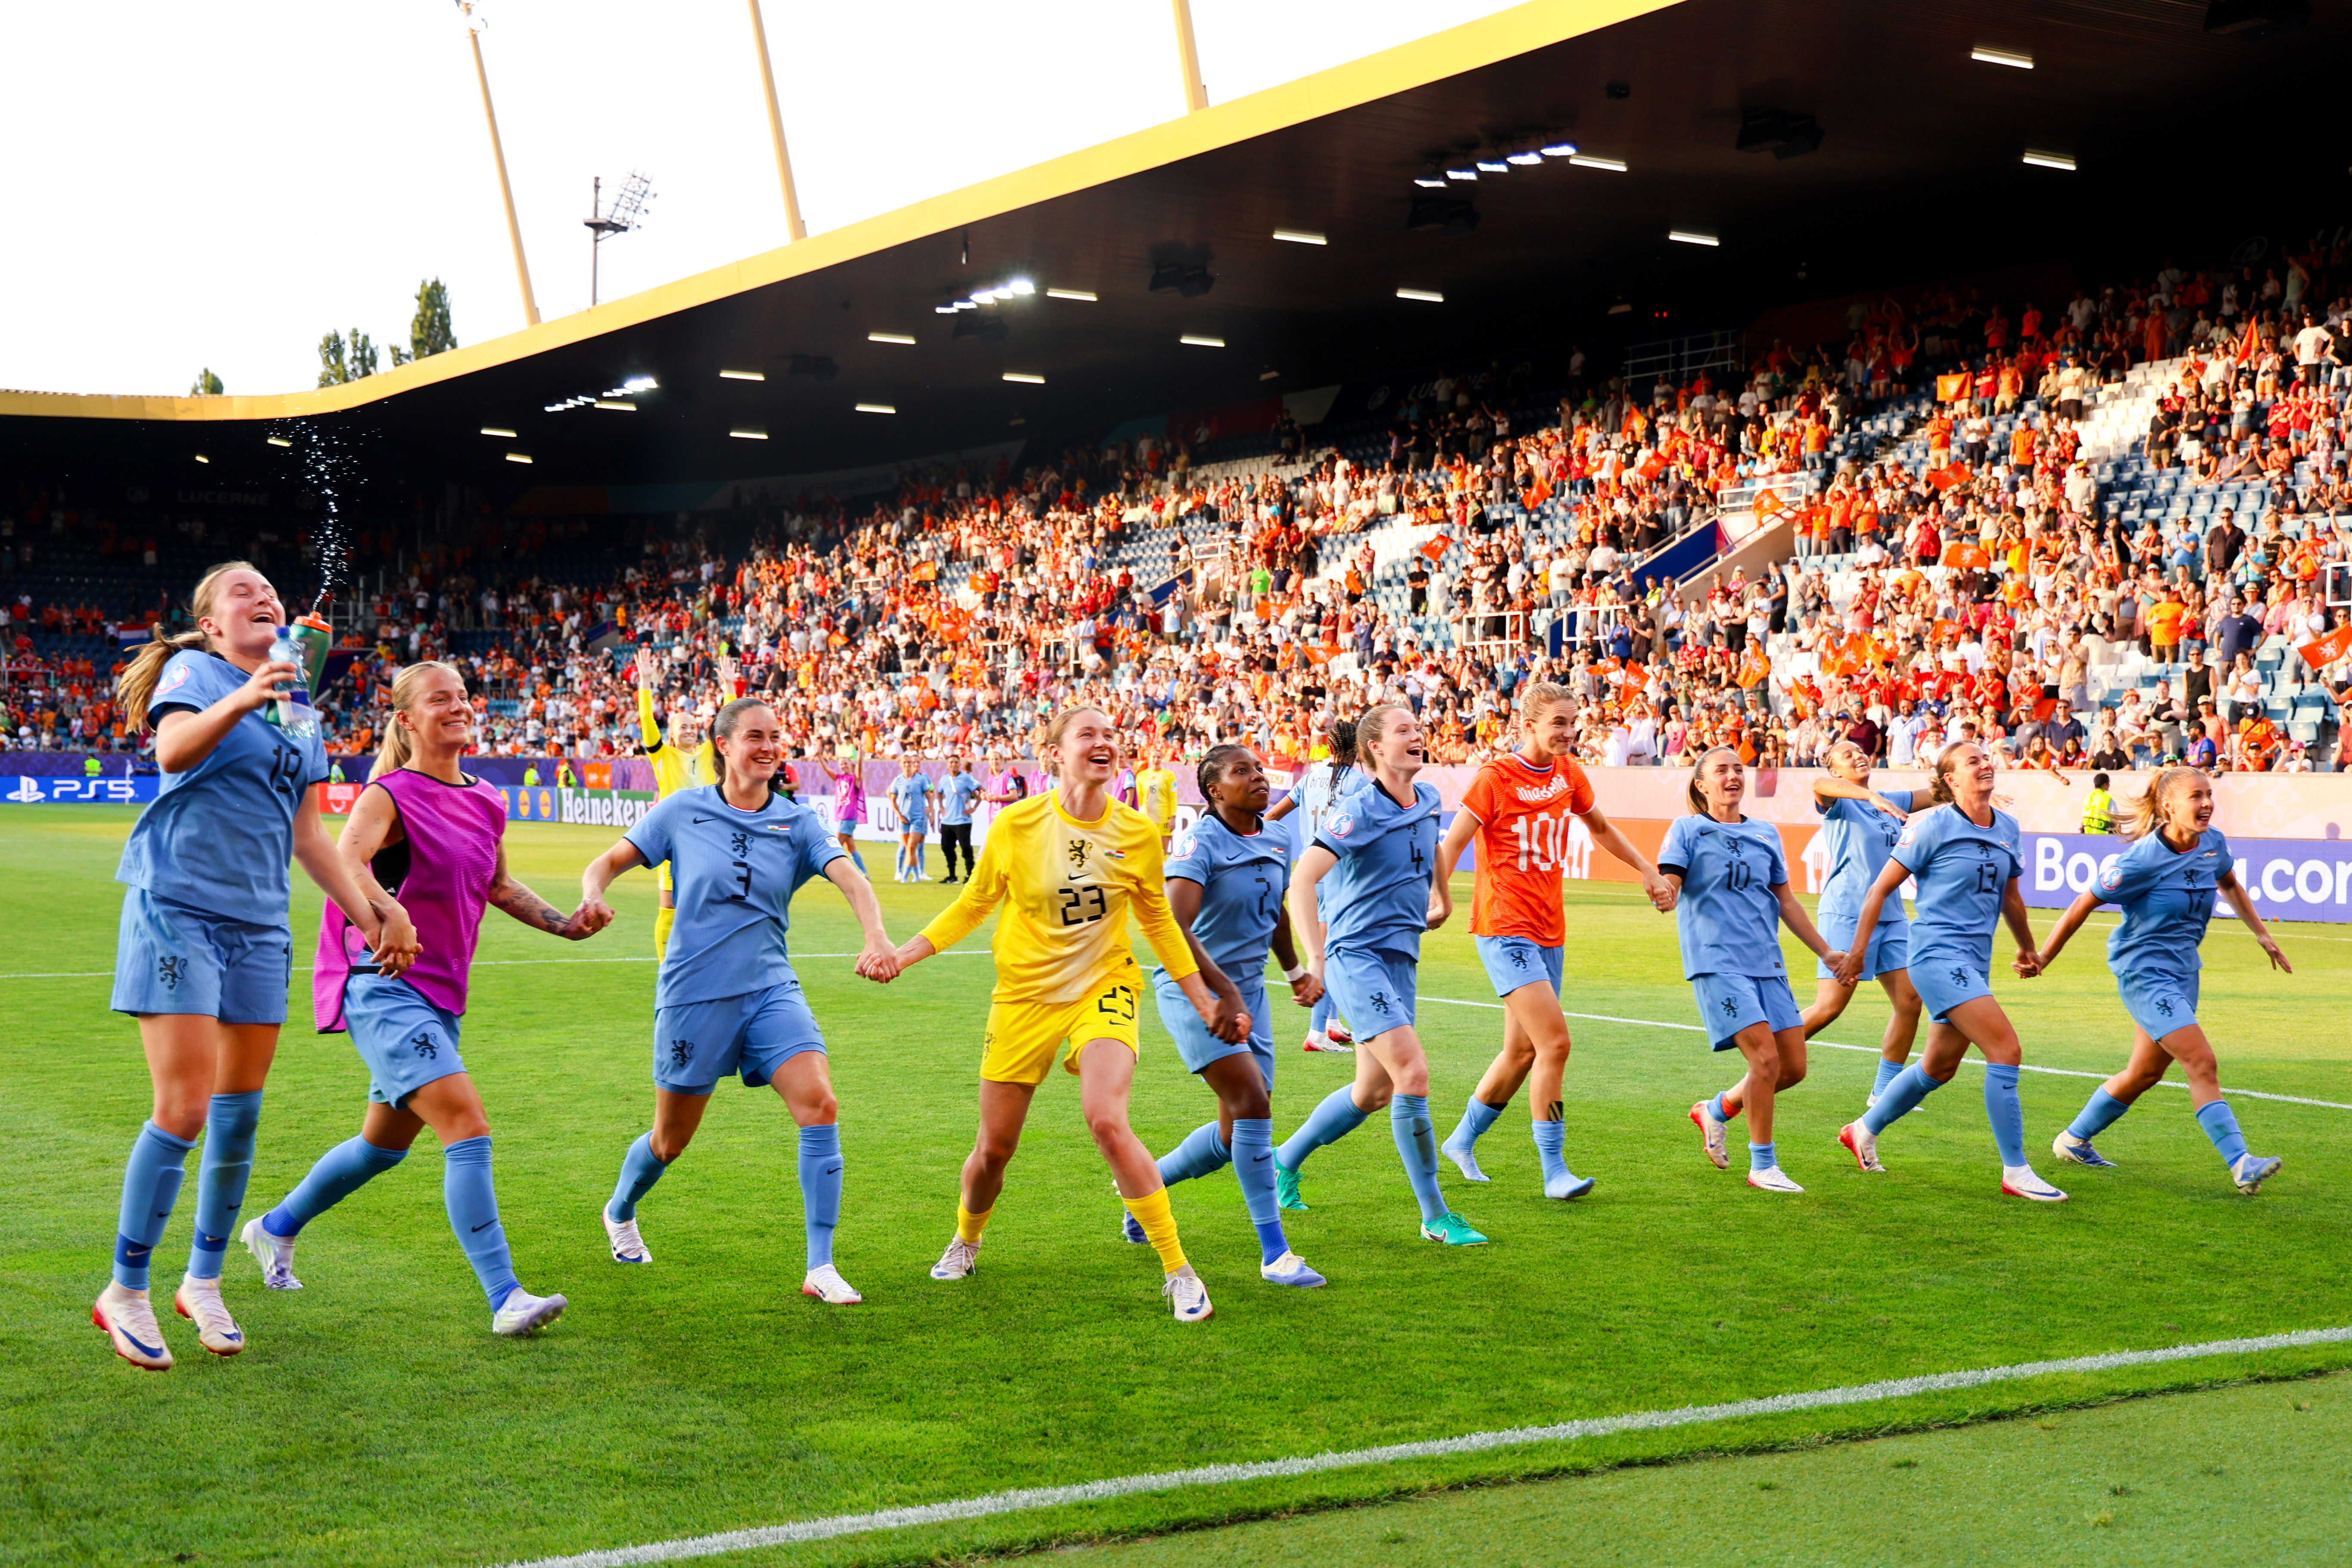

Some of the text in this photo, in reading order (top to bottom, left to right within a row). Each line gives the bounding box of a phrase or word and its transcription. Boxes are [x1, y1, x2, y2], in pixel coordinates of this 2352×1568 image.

[177, 490, 271, 506] LUCERNE
[270, 745, 303, 793] 19
[692, 759, 696, 775] 1
[53, 780, 135, 798] PS5
[561, 788, 647, 827] Heineken
[1410, 841, 1424, 874] 4
[731, 861, 751, 901] 3
[1725, 860, 1750, 891] 10
[1976, 863, 1998, 893] 13
[1059, 885, 1106, 926] 23
[1255, 877, 1271, 915] 7
[1098, 985, 1134, 1021] 23
